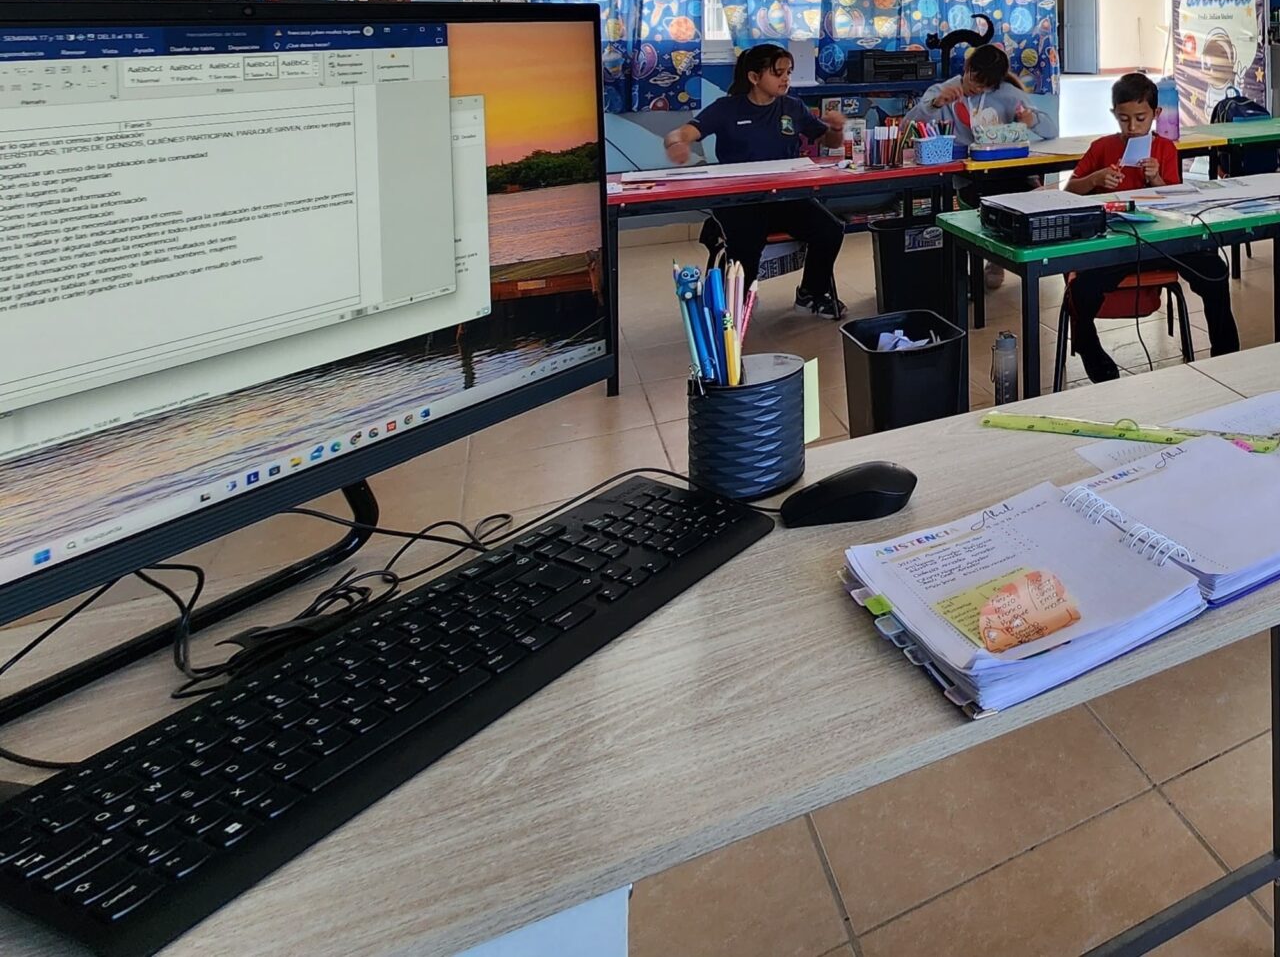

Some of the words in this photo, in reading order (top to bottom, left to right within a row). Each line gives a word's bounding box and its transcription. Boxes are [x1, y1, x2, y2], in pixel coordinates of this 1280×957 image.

[124, 121, 144, 130] Fase
[62, 145, 90, 154] TIPOS
[147, 135, 185, 145] QUIÉNES
[1087, 466, 1145, 489] SISTENCIA
[874, 527, 960, 557] ASISTENCIA
[970, 503, 1014, 532] Abril
